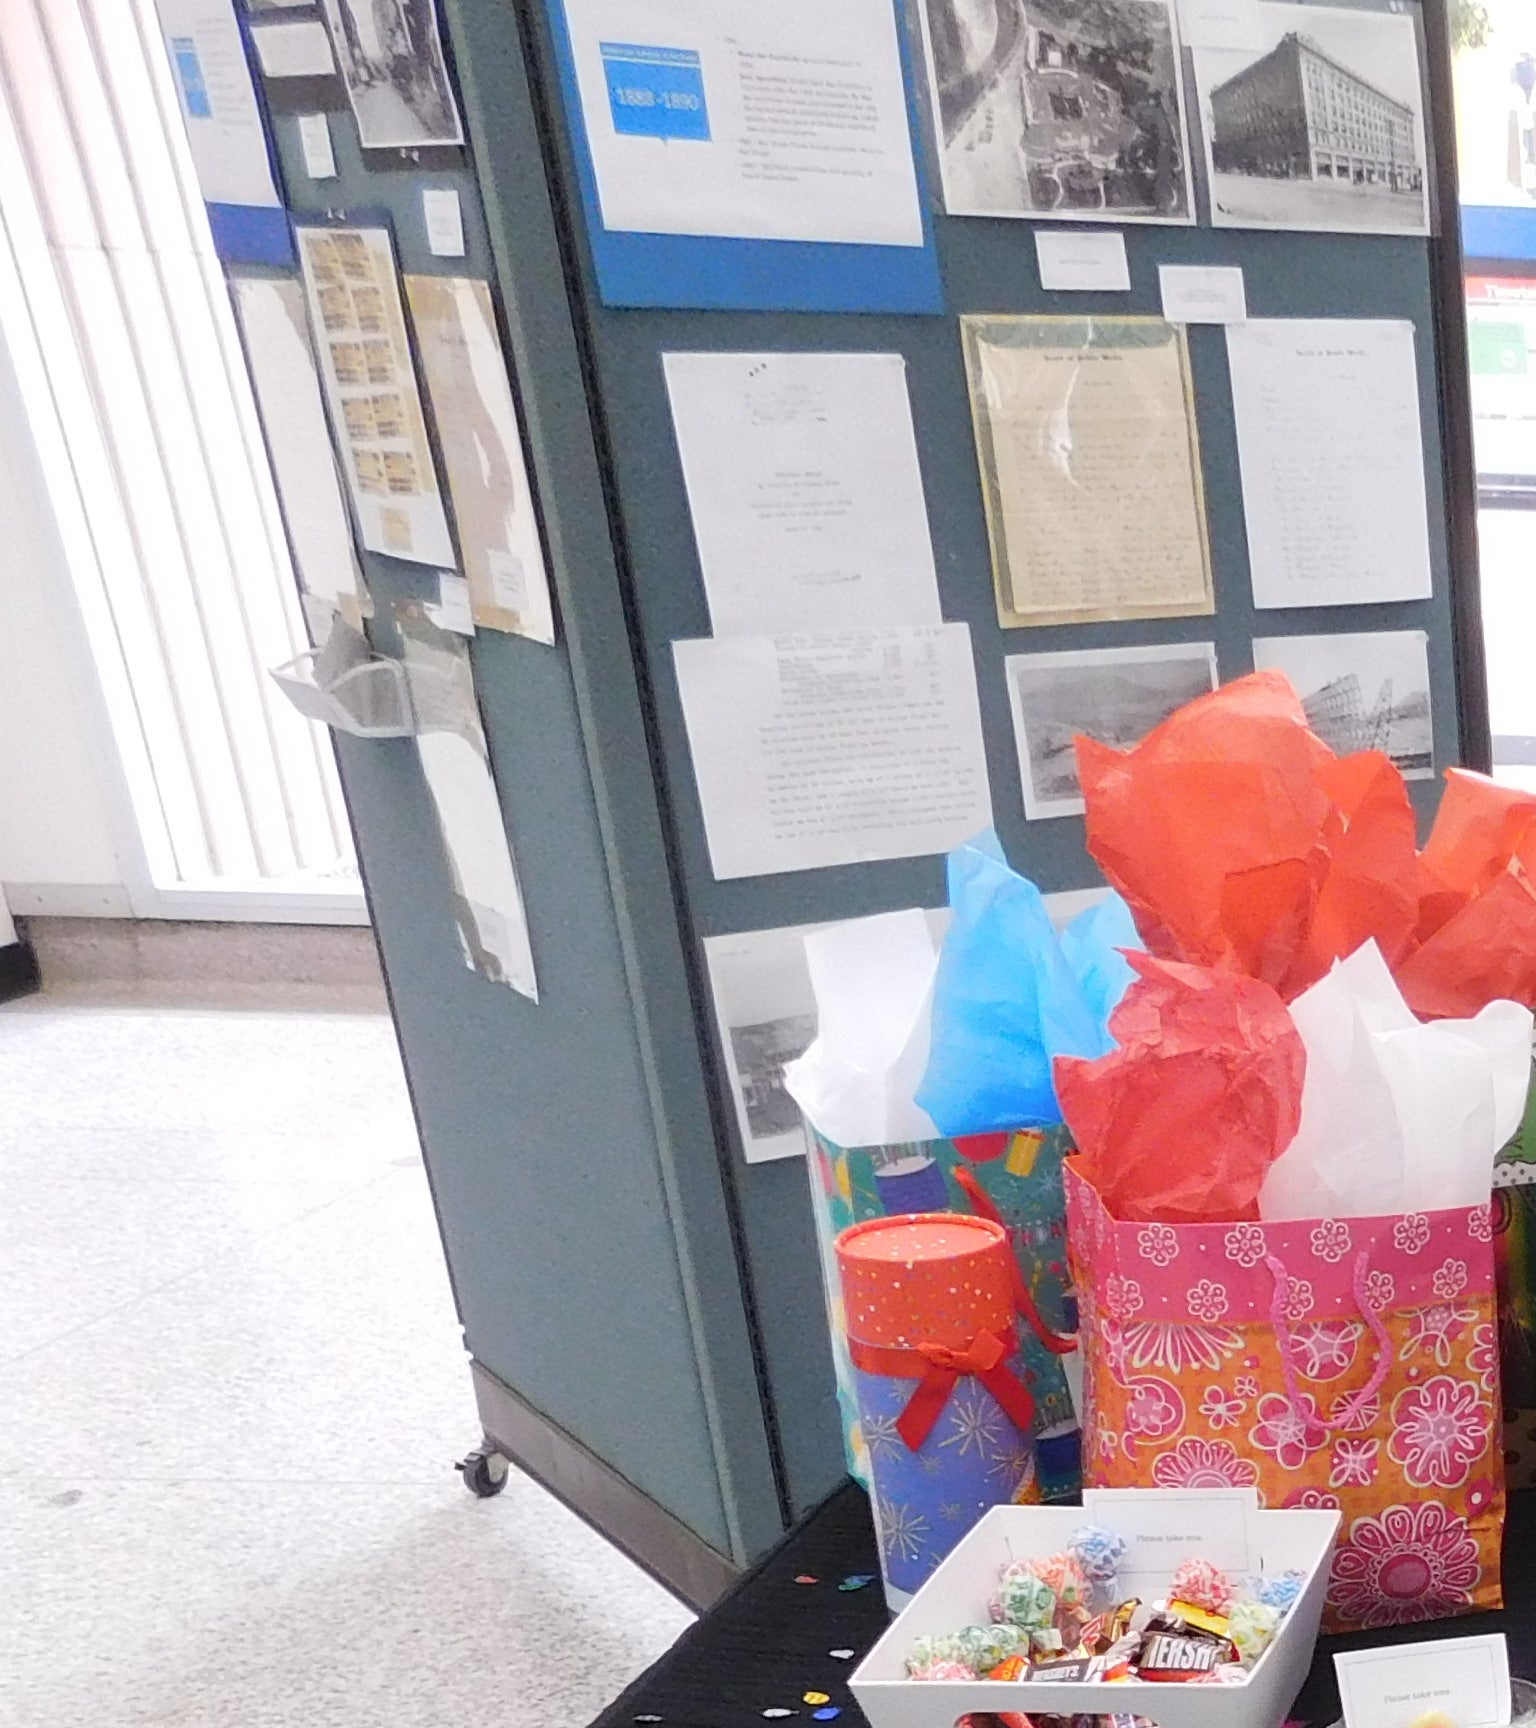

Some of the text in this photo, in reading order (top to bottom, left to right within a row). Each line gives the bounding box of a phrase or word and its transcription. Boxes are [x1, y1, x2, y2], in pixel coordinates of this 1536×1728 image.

[1136, 1534, 1163, 1542] Please
[1383, 1693, 1411, 1705] Please
[1412, 1690, 1432, 1702] take
